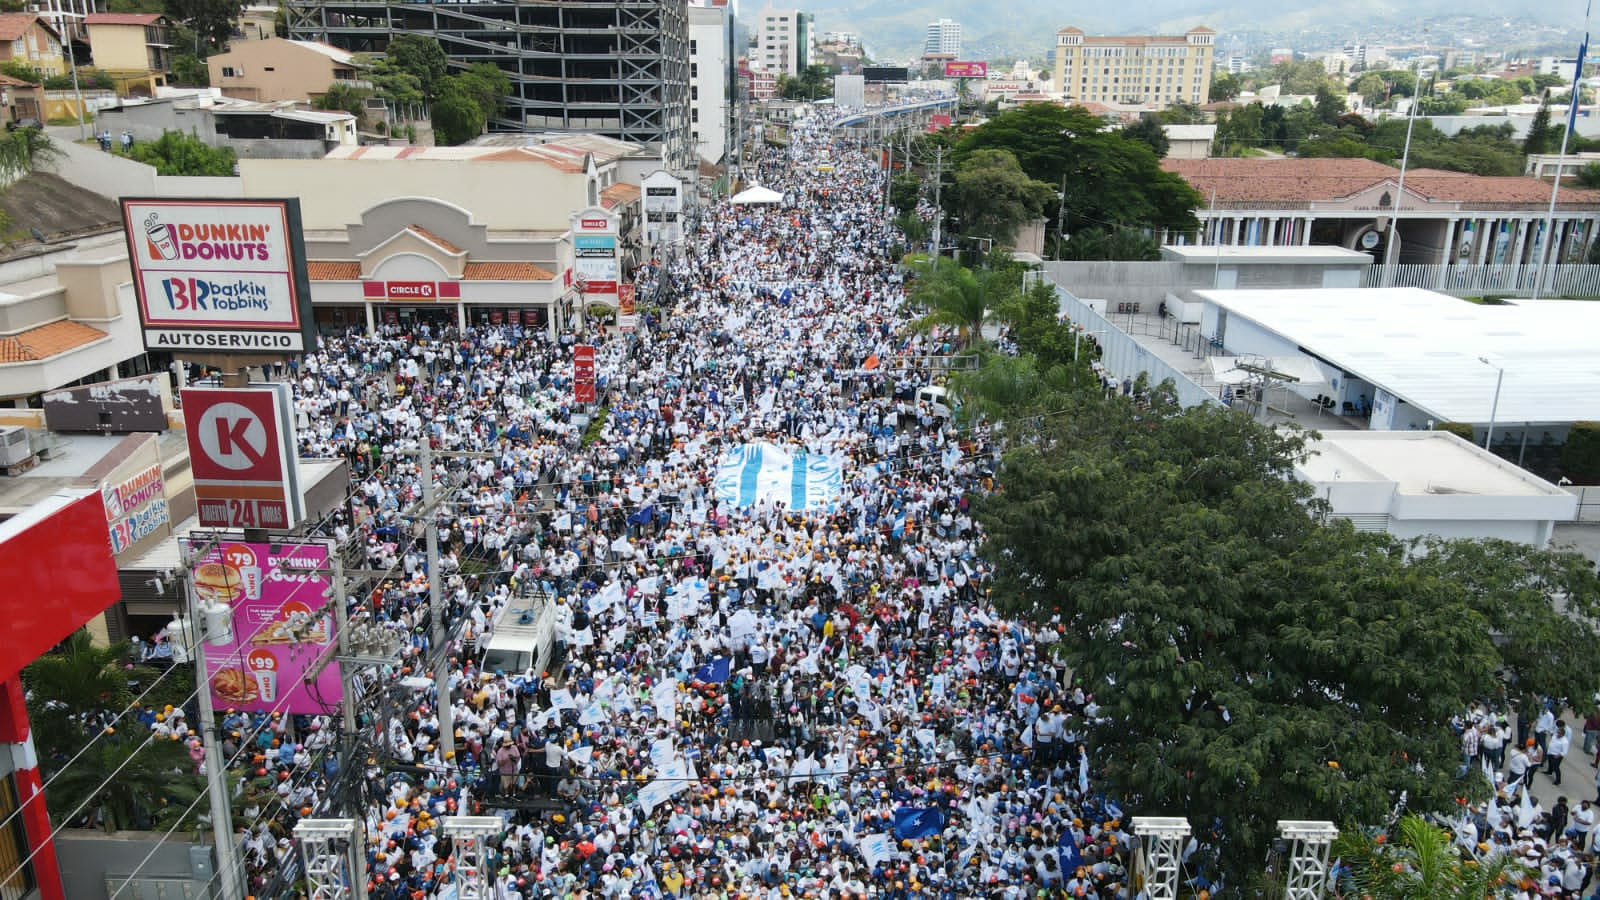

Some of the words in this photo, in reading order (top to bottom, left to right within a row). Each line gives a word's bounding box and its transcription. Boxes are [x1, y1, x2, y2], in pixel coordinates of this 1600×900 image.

[178, 224, 270, 241] DUNKIN'
[182, 243, 269, 261] DONUTS
[162, 277, 210, 311] BR
[209, 280, 266, 297] baskin
[390, 286, 420, 294] CIRCLE
[212, 296, 269, 311] robbins
[158, 333, 291, 346] AUTOSERVICIO
[215, 417, 263, 467] K
[123, 480, 163, 512] DONUTS
[229, 499, 256, 528] 24
[261, 506, 283, 524] HORAS
